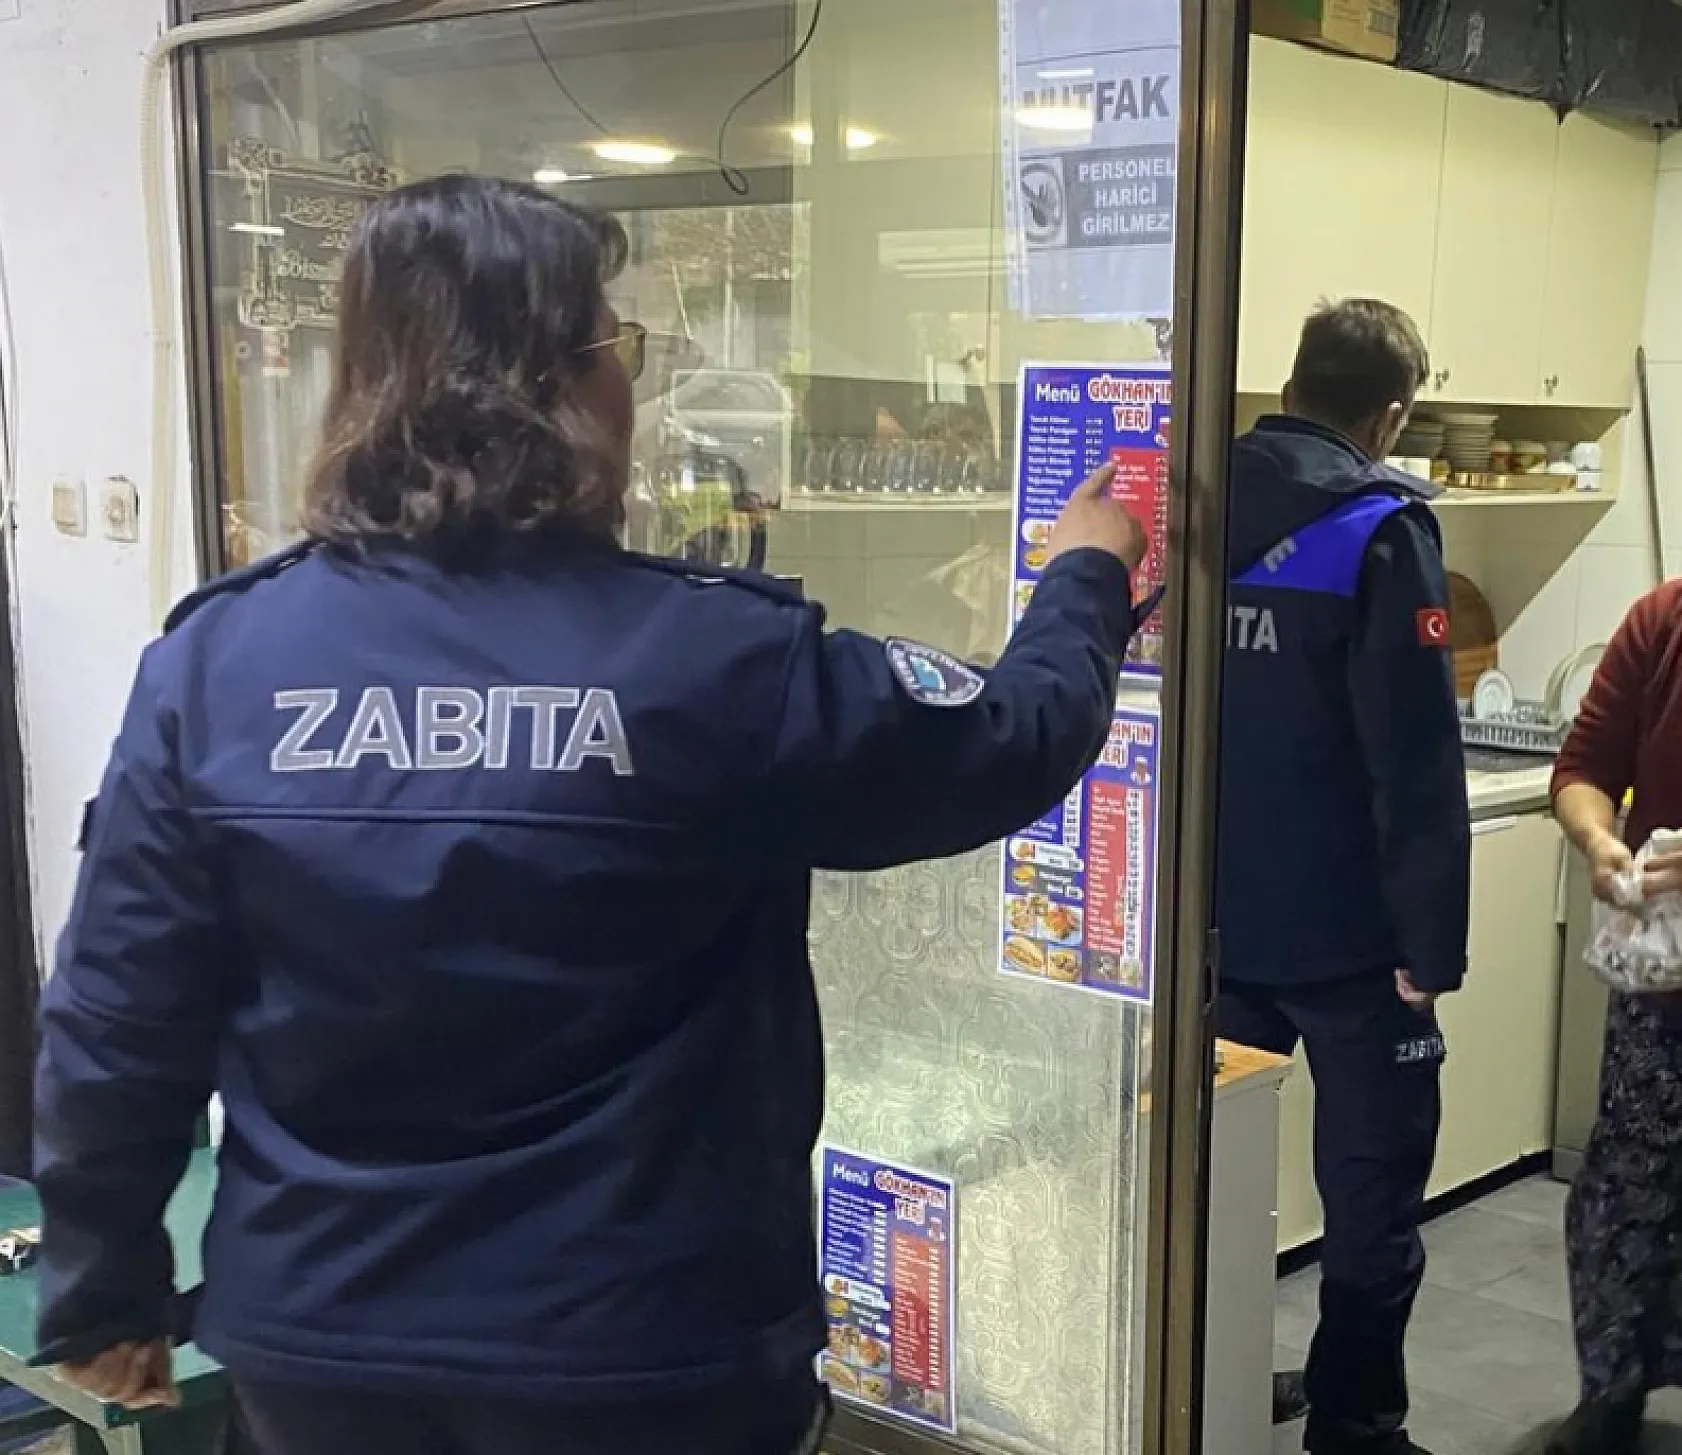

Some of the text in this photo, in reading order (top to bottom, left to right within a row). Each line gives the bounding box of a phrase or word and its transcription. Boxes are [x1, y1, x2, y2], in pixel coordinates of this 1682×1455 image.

[1079, 157, 1176, 182] PERSONEL
[1083, 211, 1172, 236] GİRİLMEZ
[1035, 383, 1081, 403] Menü
[270, 686, 634, 776] ZABITA
